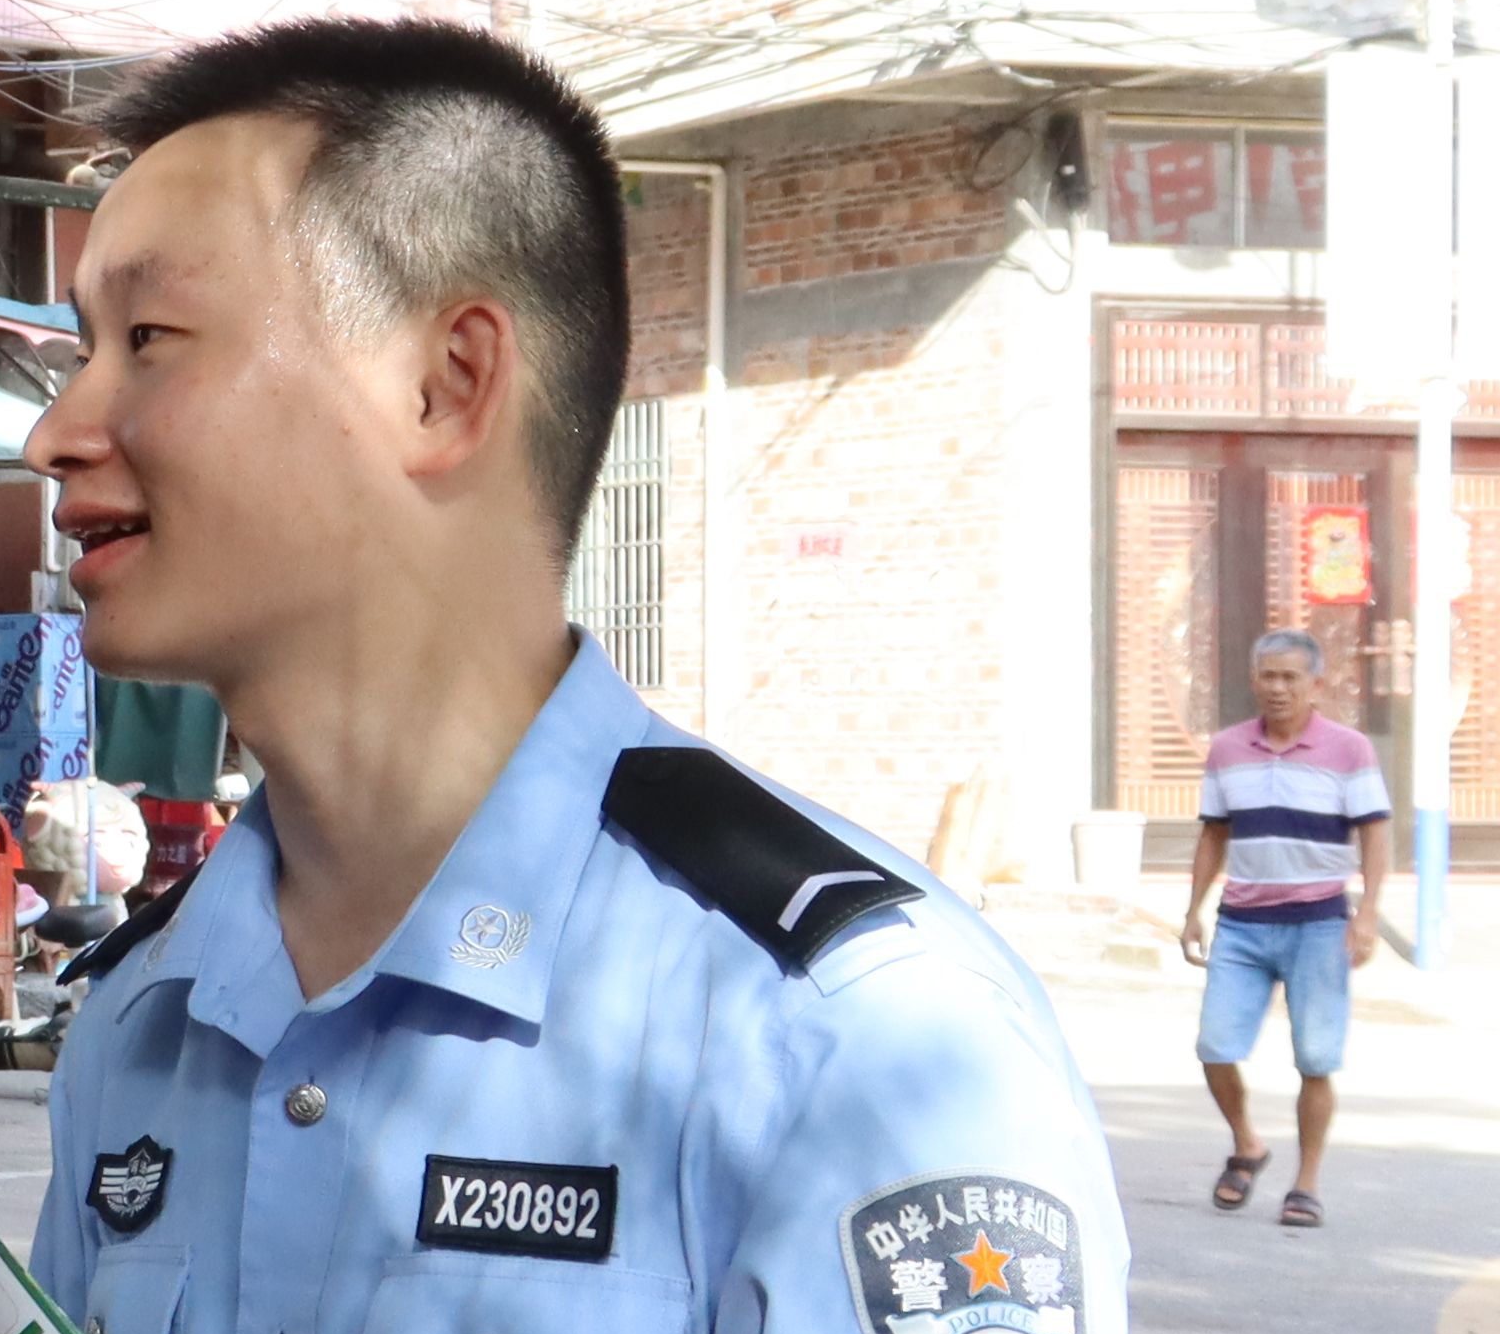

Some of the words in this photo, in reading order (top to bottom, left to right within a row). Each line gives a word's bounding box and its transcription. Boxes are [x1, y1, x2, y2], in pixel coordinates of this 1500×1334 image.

[434, 1175, 601, 1239] X230892
[865, 1186, 1067, 1261] 中华人民共和国
[949, 1303, 1034, 1334] POLICE
